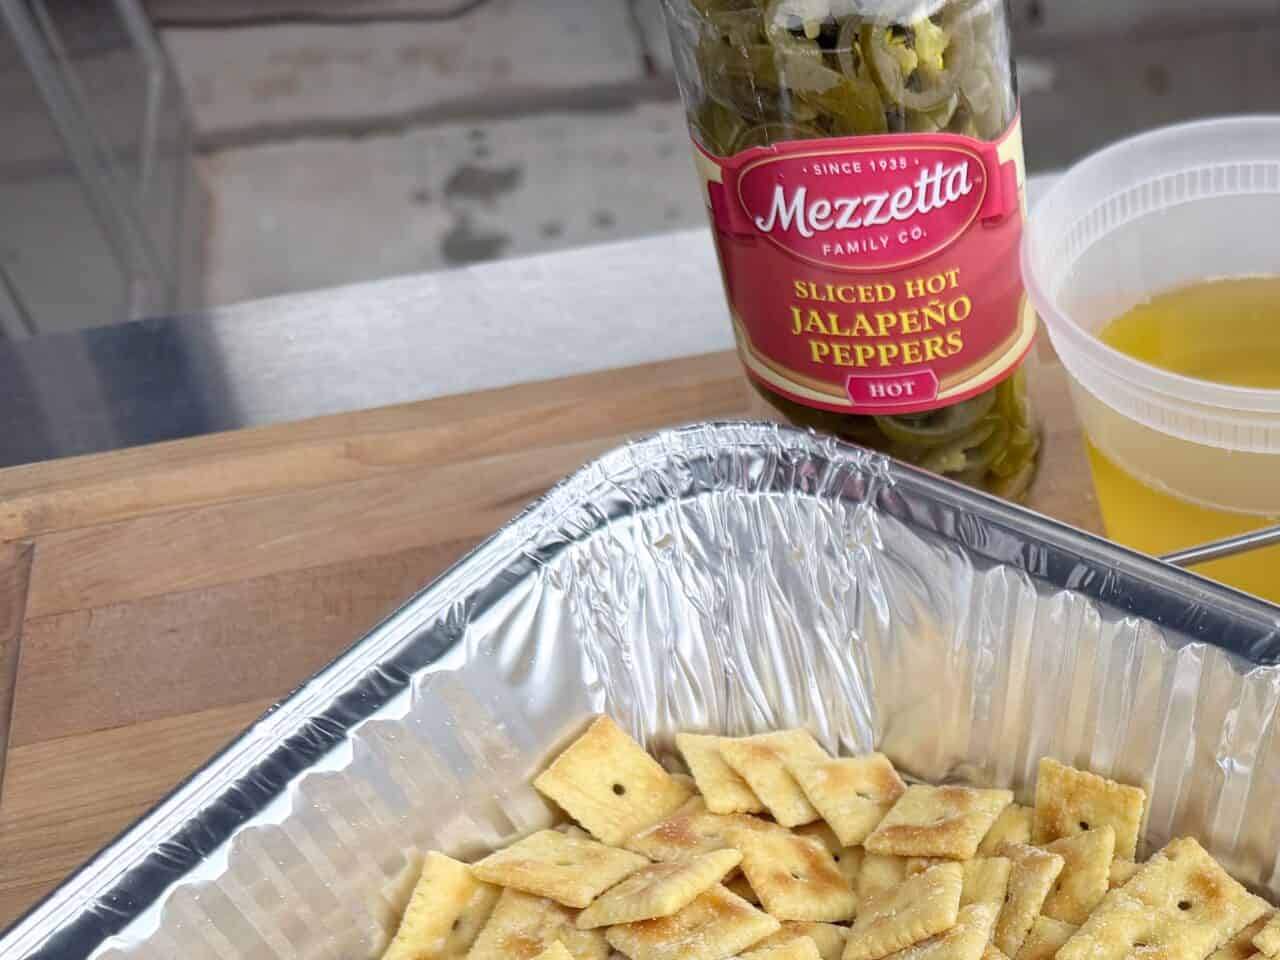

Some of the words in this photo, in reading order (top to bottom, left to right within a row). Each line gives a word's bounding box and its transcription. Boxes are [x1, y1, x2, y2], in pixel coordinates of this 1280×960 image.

[814, 162, 862, 176] SINCE
[755, 161, 973, 238] Mezzetta
[823, 237, 889, 256] FAMILY
[898, 227, 927, 244] CO.
[794, 279, 896, 303] SLICED
[905, 269, 960, 299] HOT
[791, 295, 972, 337] JALAPEÑO
[809, 331, 964, 367] PEPPERS
[869, 383, 916, 398] HOT
